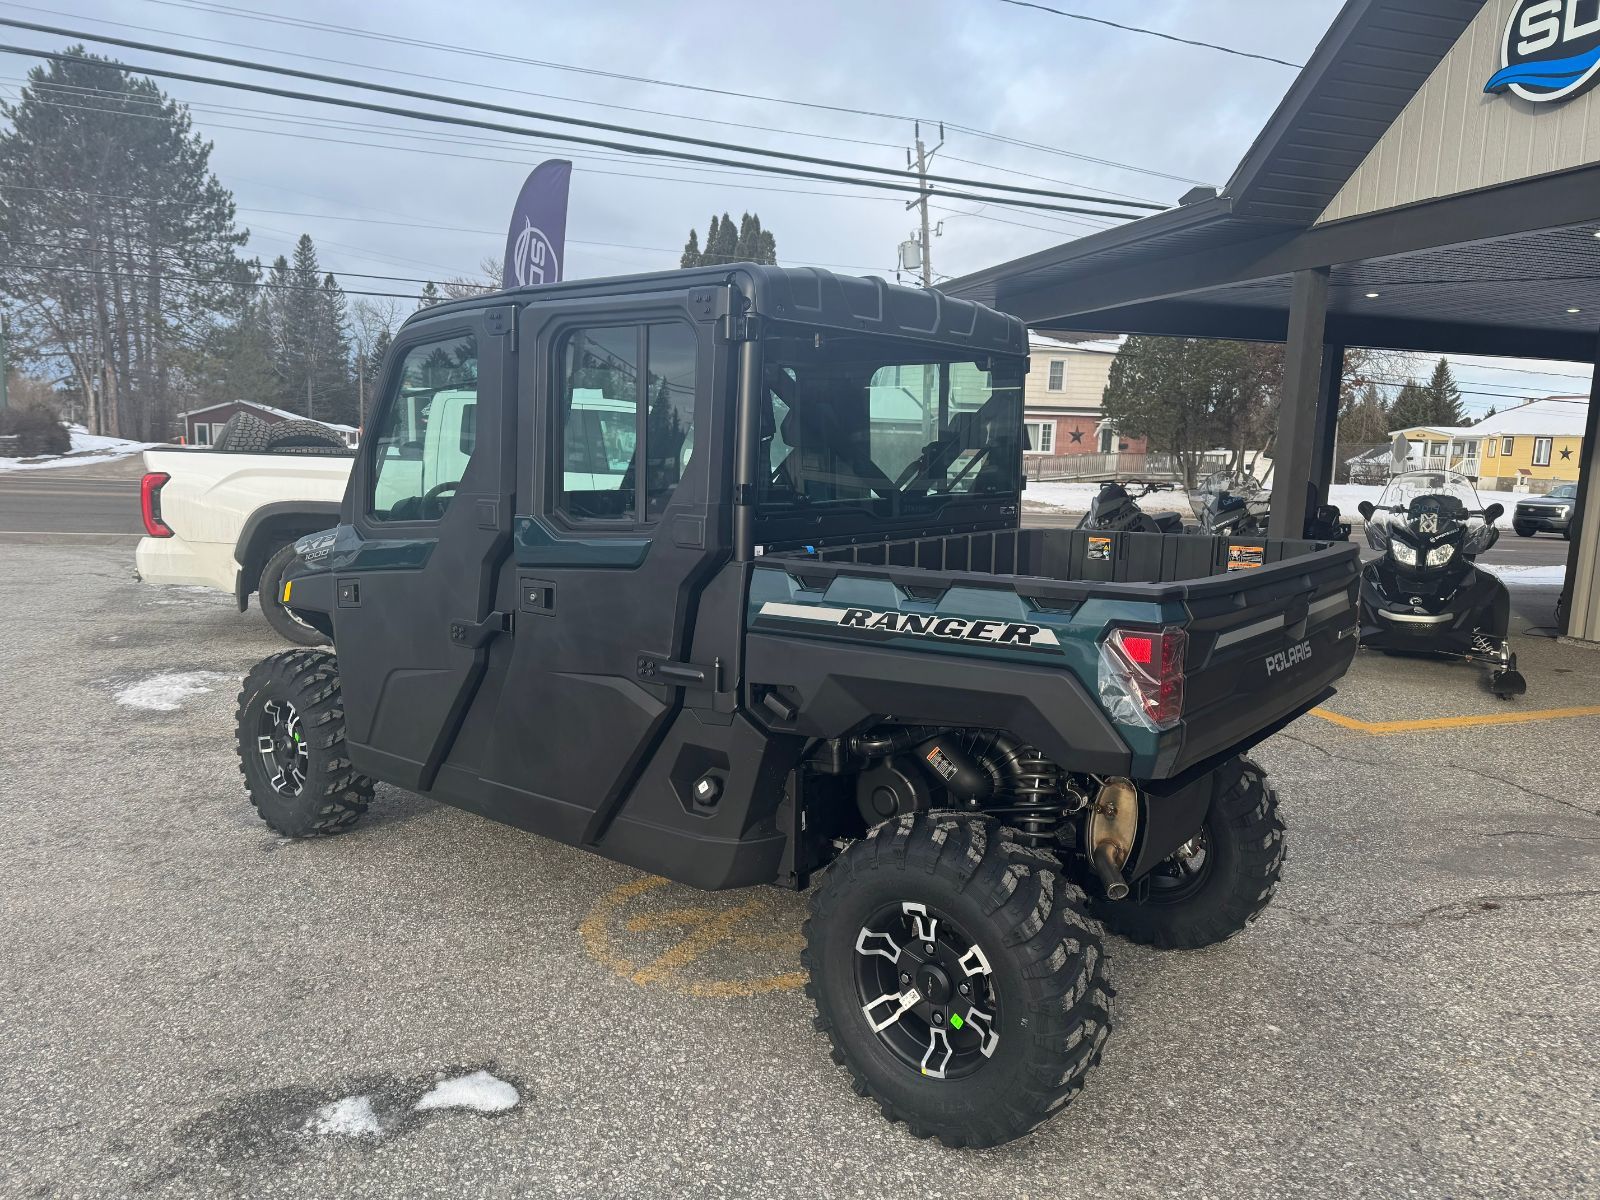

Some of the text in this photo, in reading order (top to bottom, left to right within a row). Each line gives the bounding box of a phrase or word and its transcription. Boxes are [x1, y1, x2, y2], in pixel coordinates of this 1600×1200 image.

[305, 549, 330, 560] 1000
[837, 607, 1040, 647] RANGER
[1265, 640, 1313, 677] POLARIS
